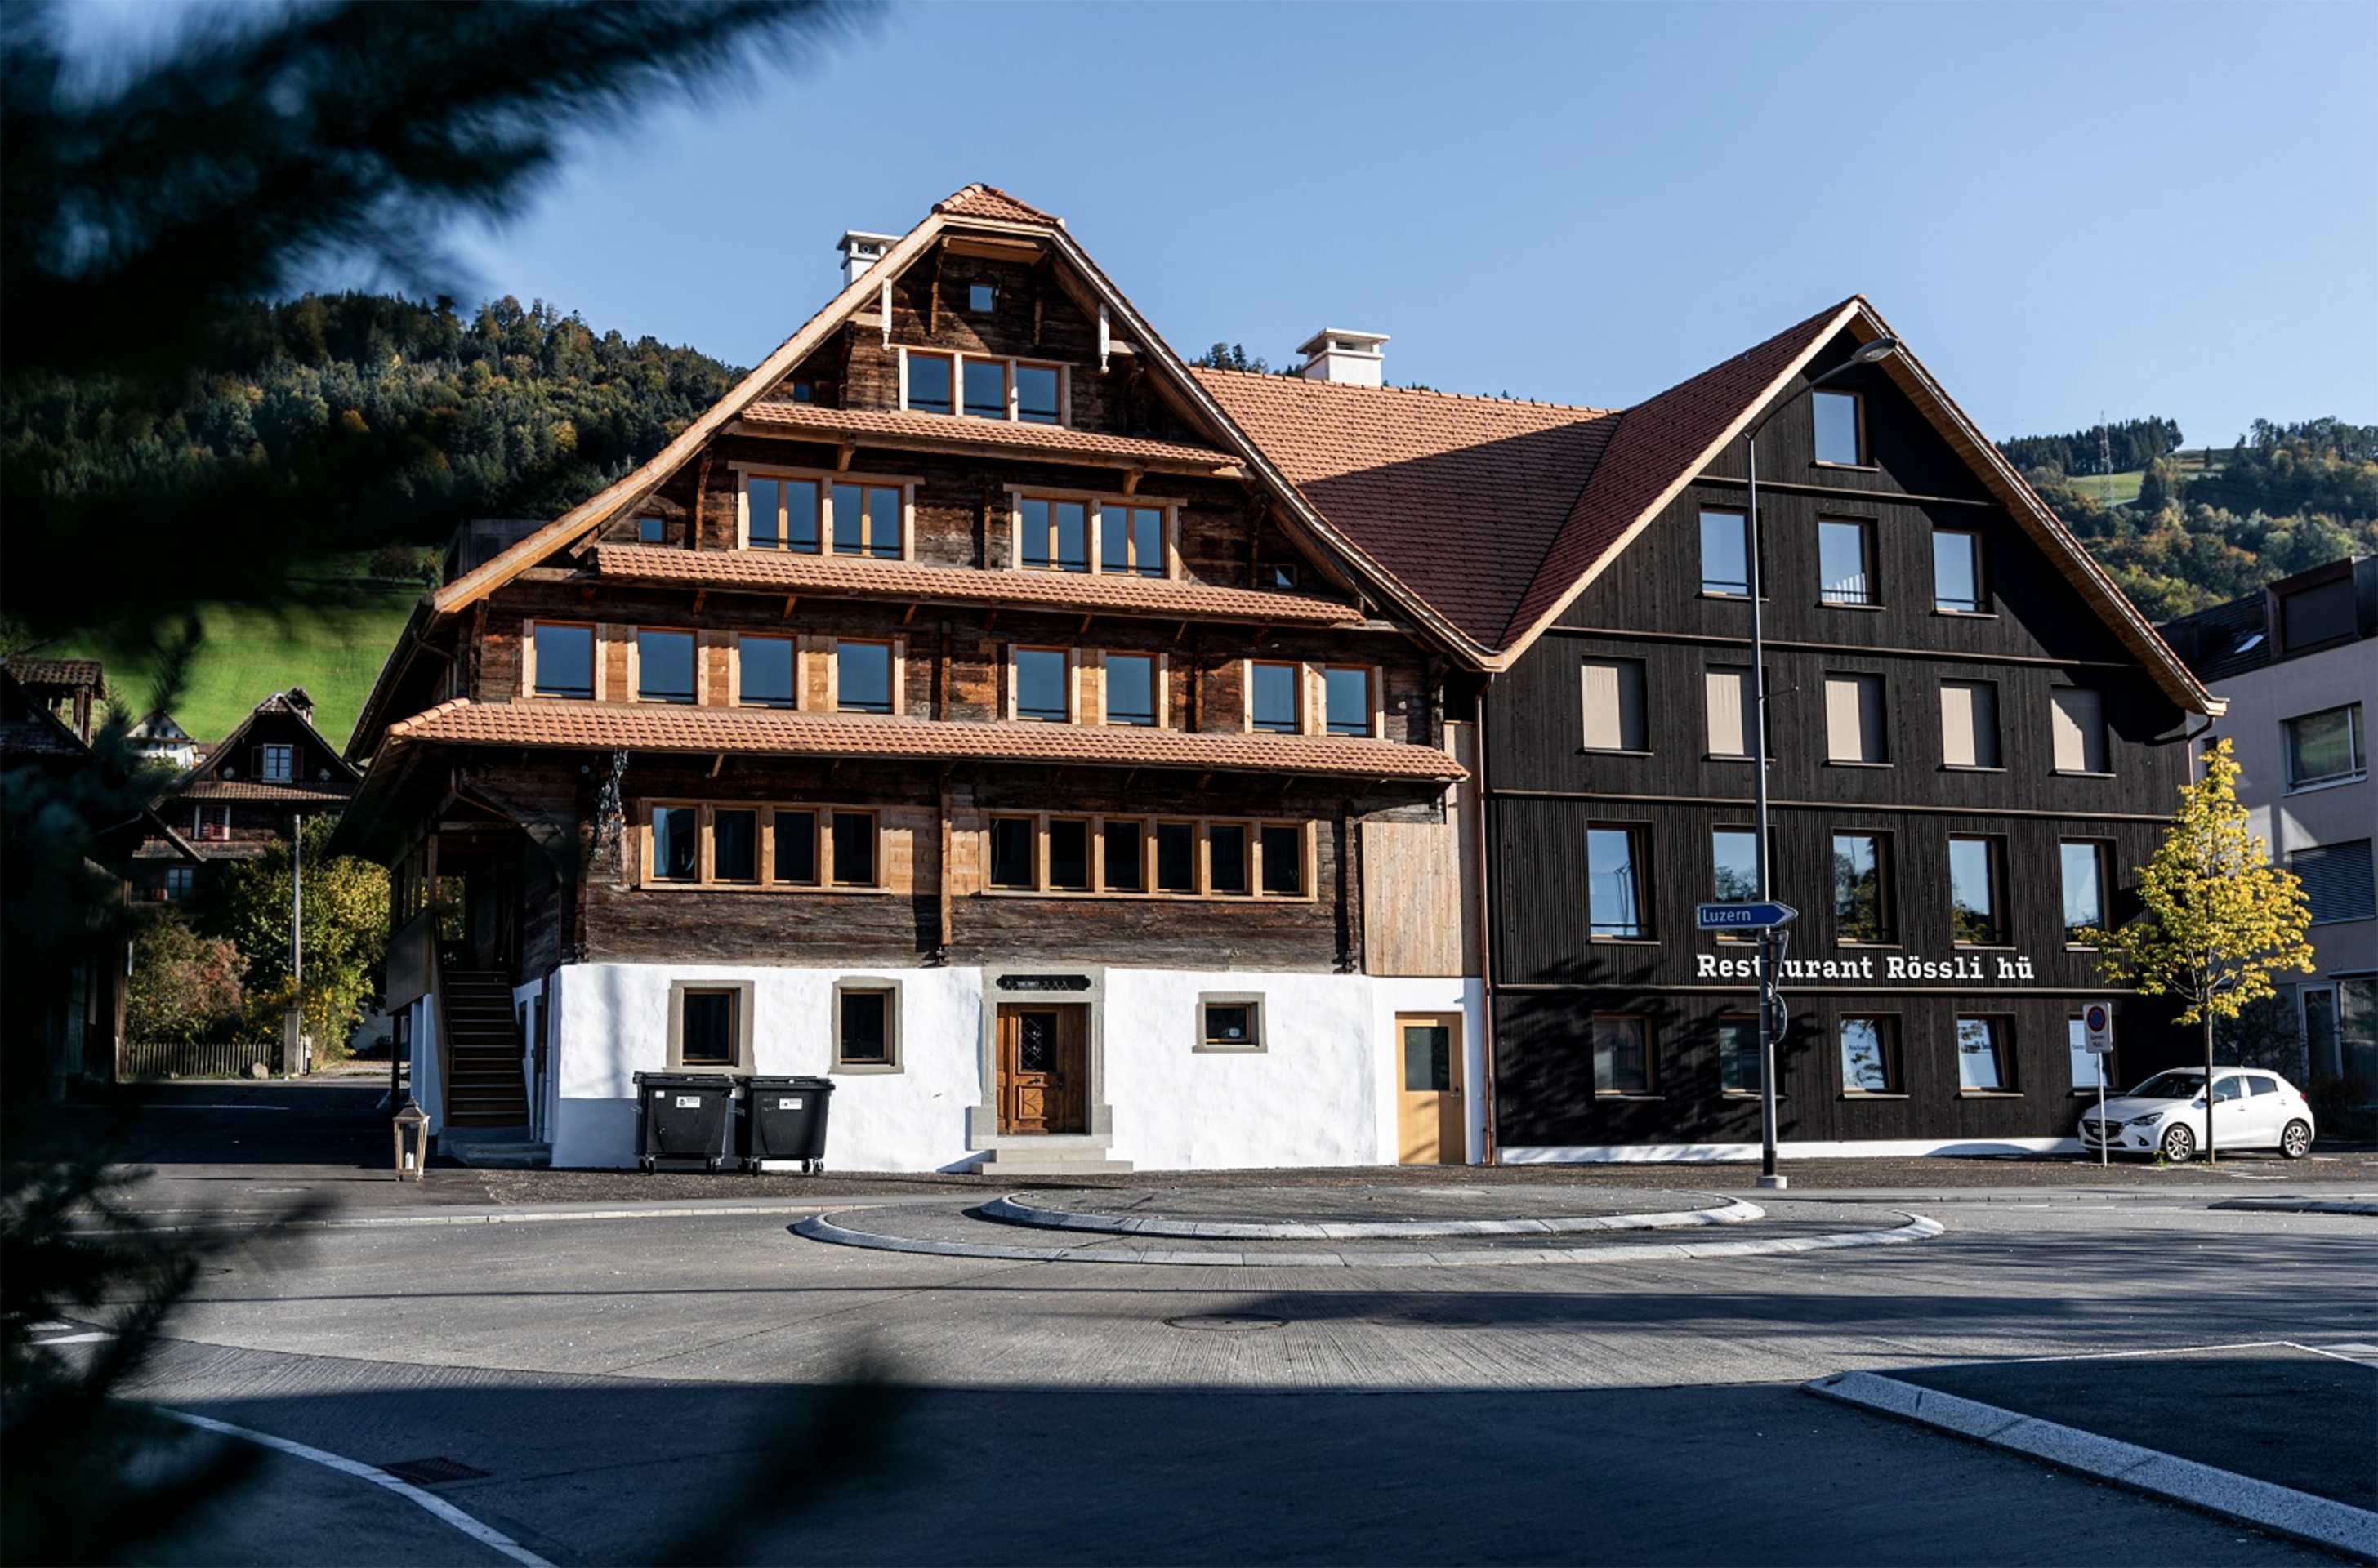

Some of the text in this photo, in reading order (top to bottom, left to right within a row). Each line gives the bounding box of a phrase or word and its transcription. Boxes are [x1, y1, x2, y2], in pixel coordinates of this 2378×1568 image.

[1702, 909, 1751, 923] Luzern
[1697, 954, 2034, 979] Resturant Rössli hü
